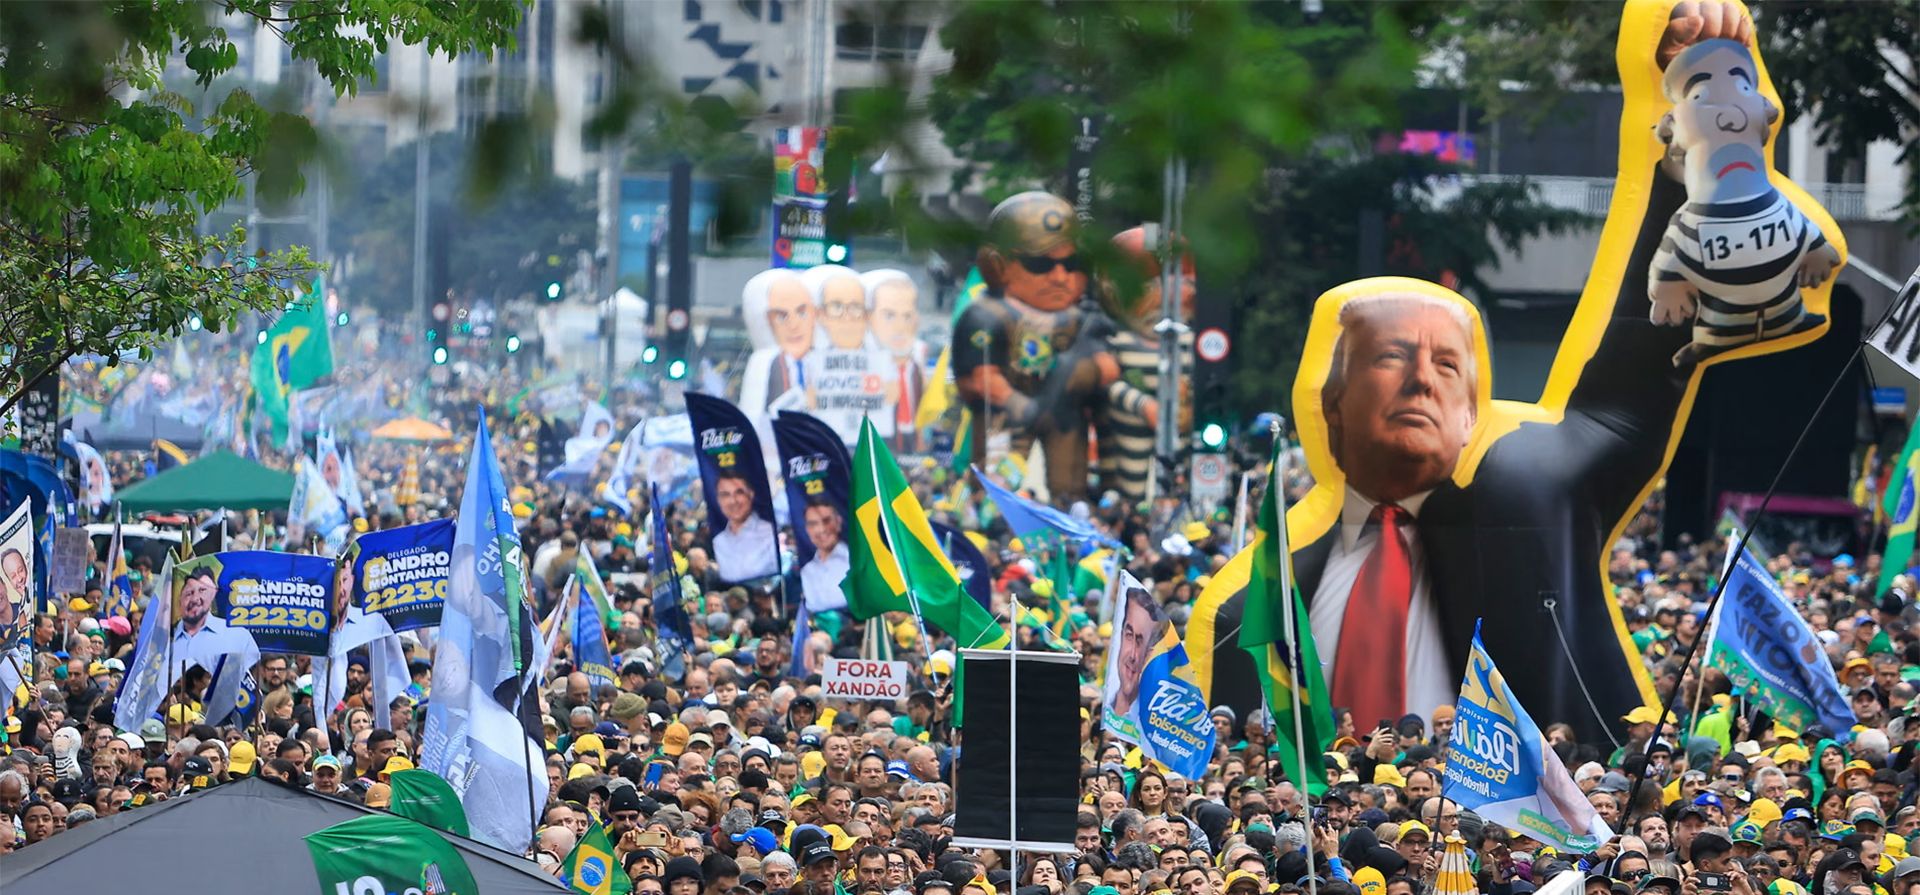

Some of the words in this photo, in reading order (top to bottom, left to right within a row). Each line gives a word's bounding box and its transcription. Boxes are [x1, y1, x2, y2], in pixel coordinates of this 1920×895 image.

[1703, 236, 1731, 261] 13
[1749, 219, 1790, 250] 171
[717, 452, 736, 467] 22
[805, 479, 824, 495] 22
[387, 546, 427, 559] DELEGADO
[369, 551, 450, 577] SANDRO
[369, 567, 449, 591] MONTANARI
[236, 594, 325, 609] MONTANARI
[364, 580, 448, 613] 22230
[412, 602, 443, 611] ESTADUA
[1737, 583, 1781, 627] FAZ
[1780, 620, 1799, 643] O
[230, 606, 326, 630] 22230
[837, 661, 892, 678] FORA
[826, 680, 901, 697] XANDÃO
[1149, 712, 1207, 750] Bolsonaro
[1168, 739, 1193, 758] Gaspar
